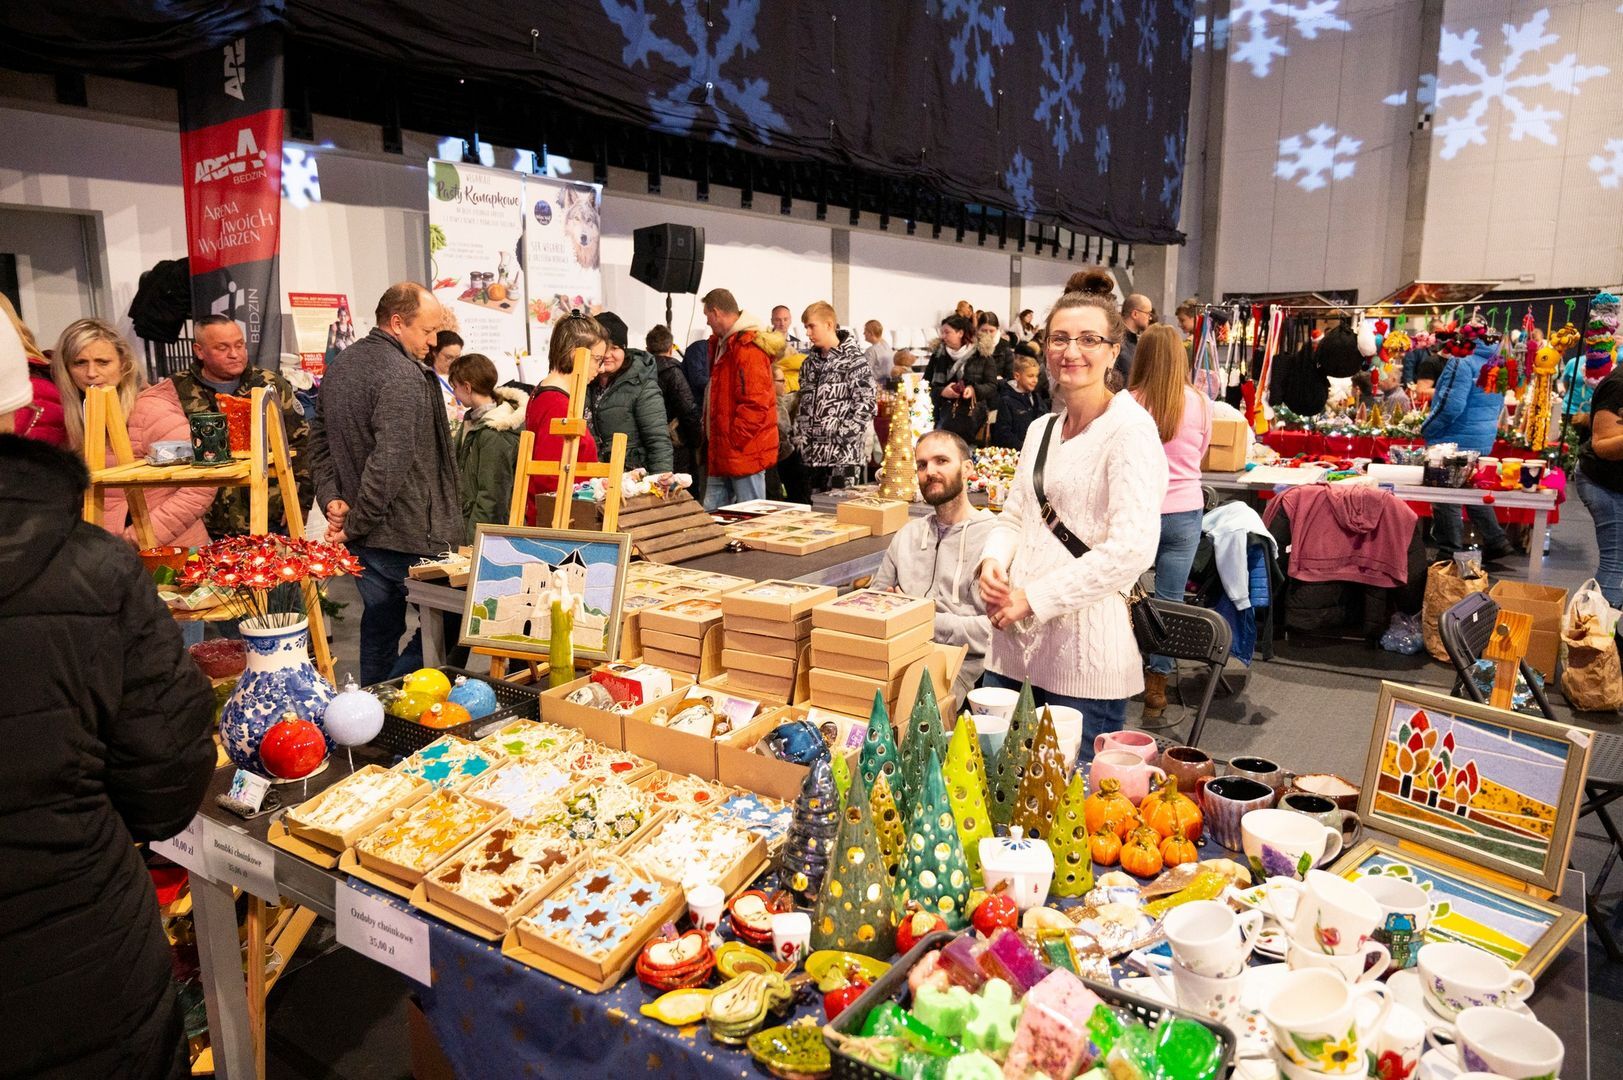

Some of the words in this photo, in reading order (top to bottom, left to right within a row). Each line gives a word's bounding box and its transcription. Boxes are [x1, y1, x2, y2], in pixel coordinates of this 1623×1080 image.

[436, 181, 463, 204] Pasty
[465, 185, 519, 208] Kanapkowe
[351, 907, 376, 928] Ozdoby
[378, 921, 413, 944] choinkowe
[369, 936, 387, 952] 35,00
[388, 945, 395, 955] zł
